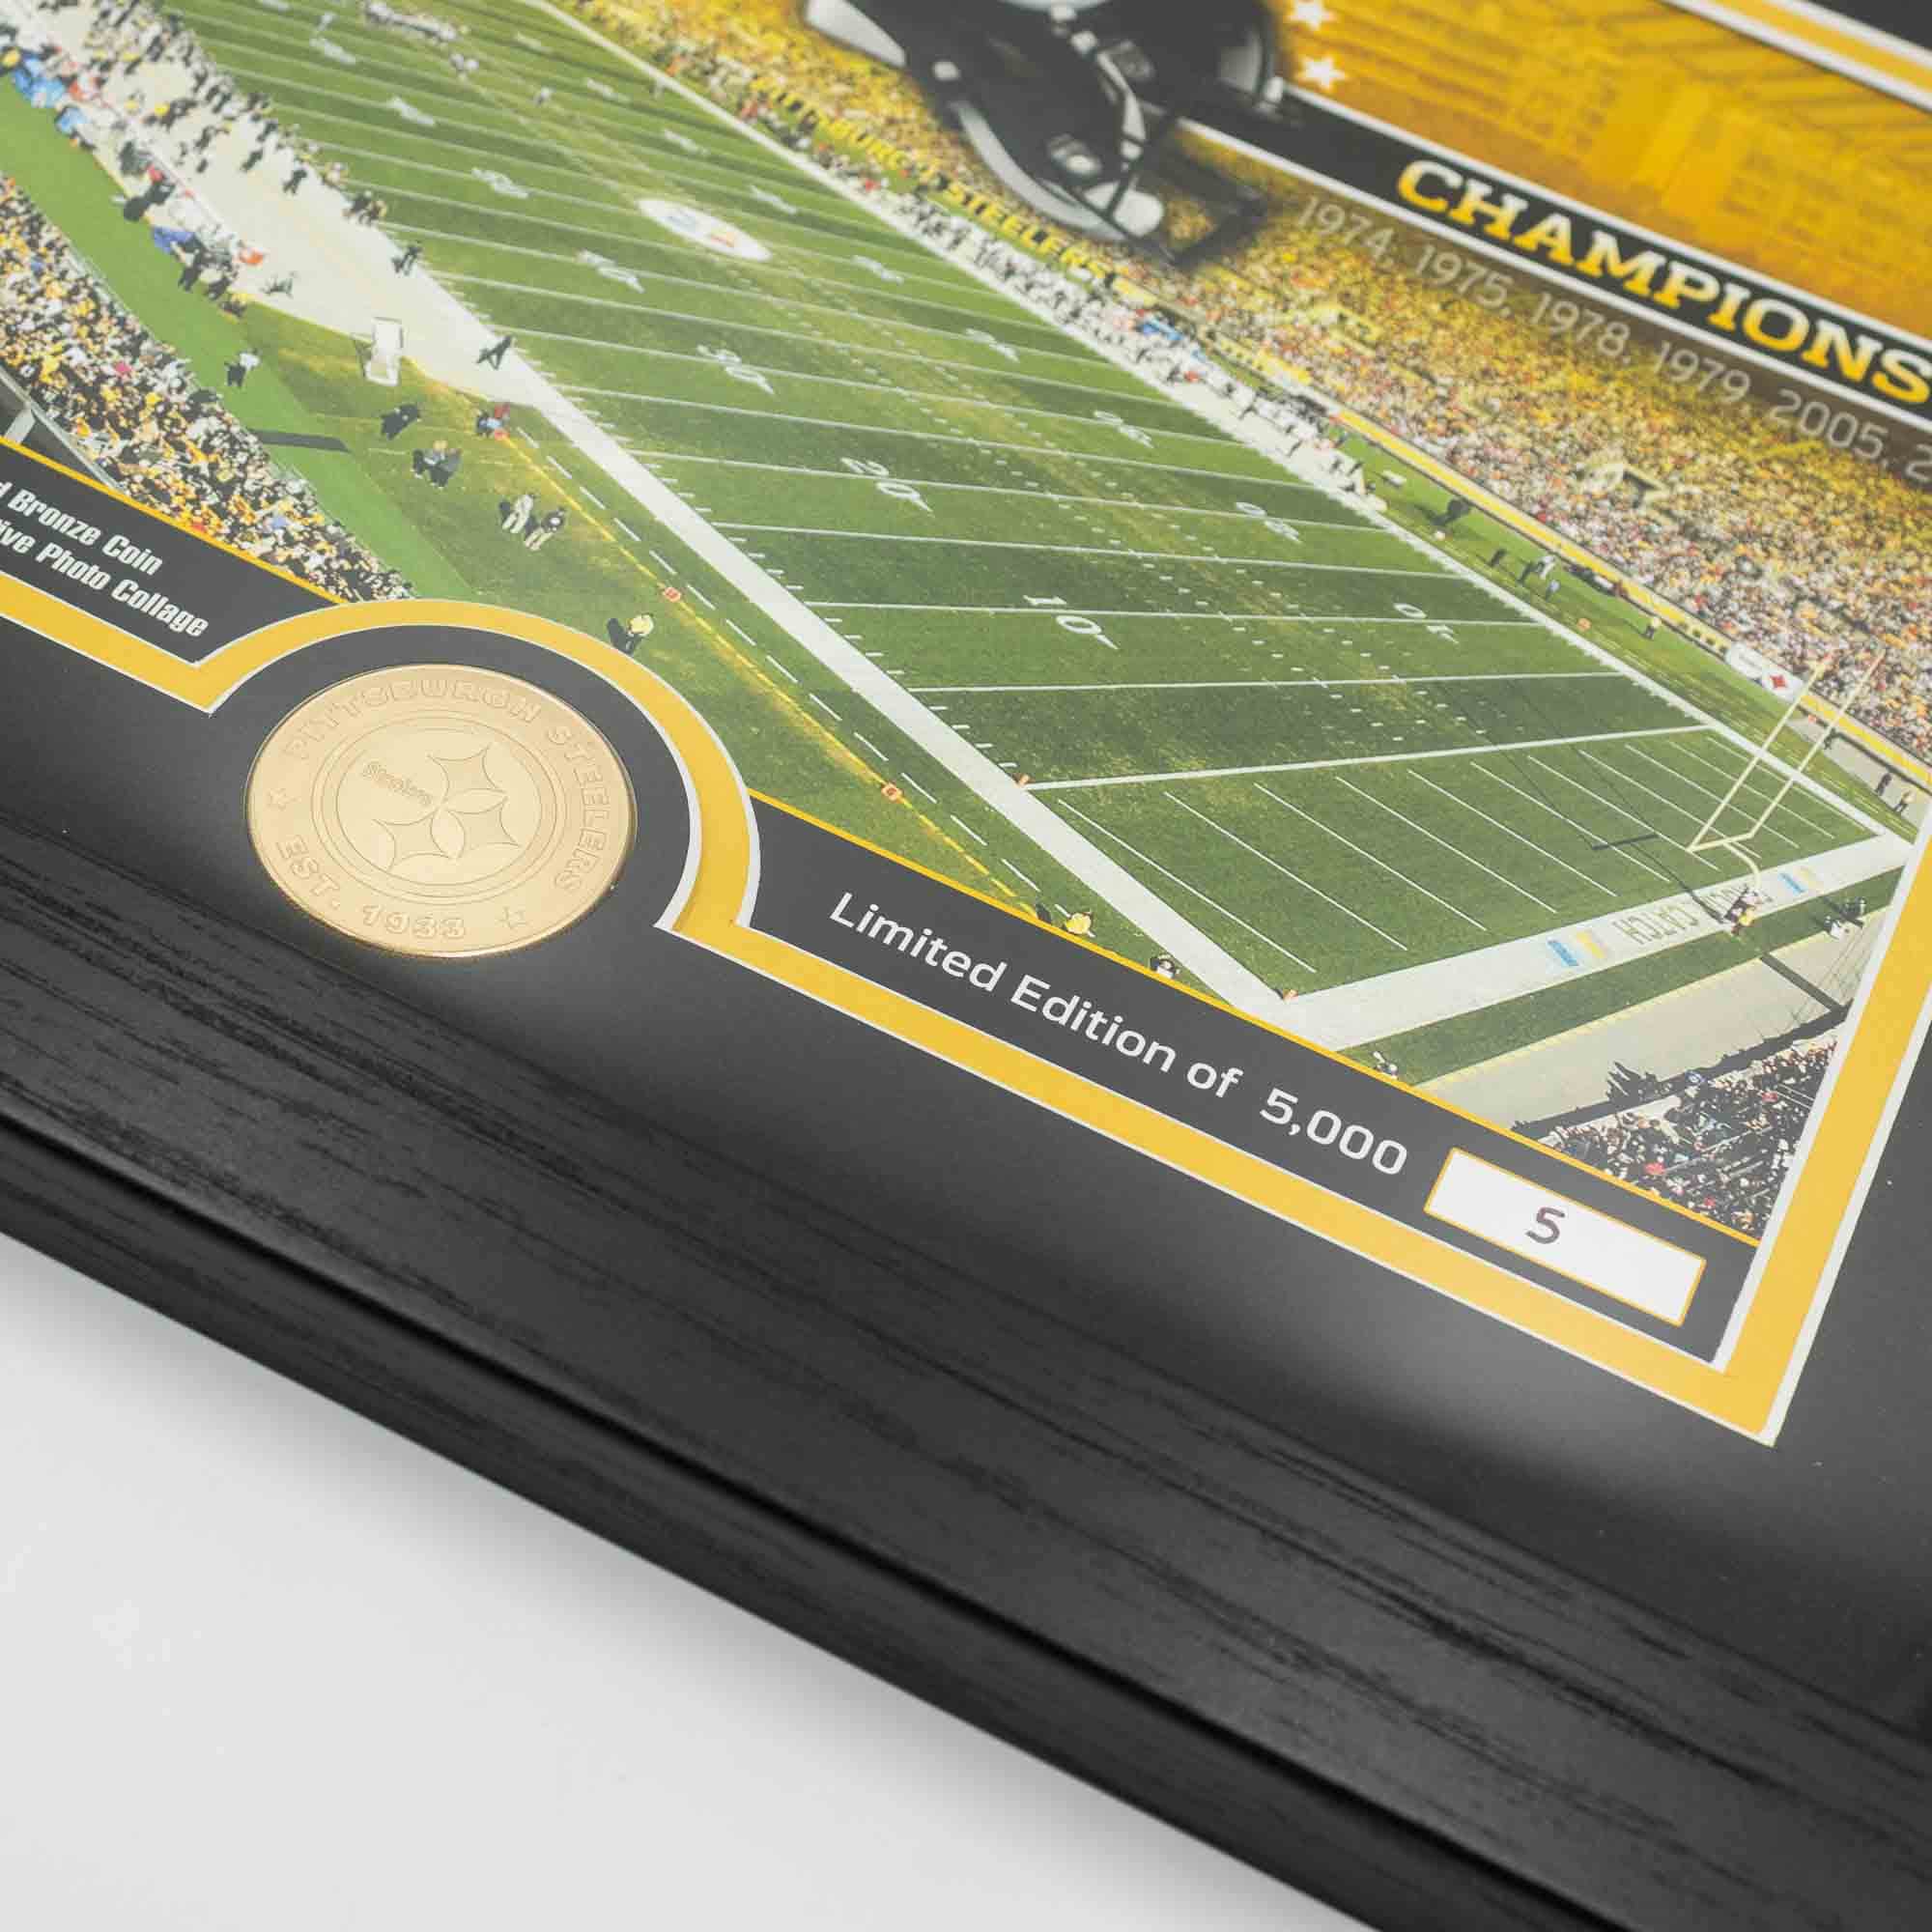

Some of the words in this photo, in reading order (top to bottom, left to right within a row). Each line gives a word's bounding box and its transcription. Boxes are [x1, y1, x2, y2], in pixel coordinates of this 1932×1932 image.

[1397, 158, 1932, 404] CHAMPIONS
[8, 489, 101, 546] Bronze
[102, 534, 163, 576] Coin
[35, 542, 111, 590] Photo
[111, 580, 209, 637] Collage
[281, 679, 542, 760] PITTSBURGH
[546, 725, 611, 891] STEELERS
[362, 904, 466, 939] 1933
[829, 892, 1008, 992] Limited
[1010, 976, 1177, 1072] Edition
[1186, 1061, 1243, 1098] of
[1259, 1088, 1408, 1176] 5,000
